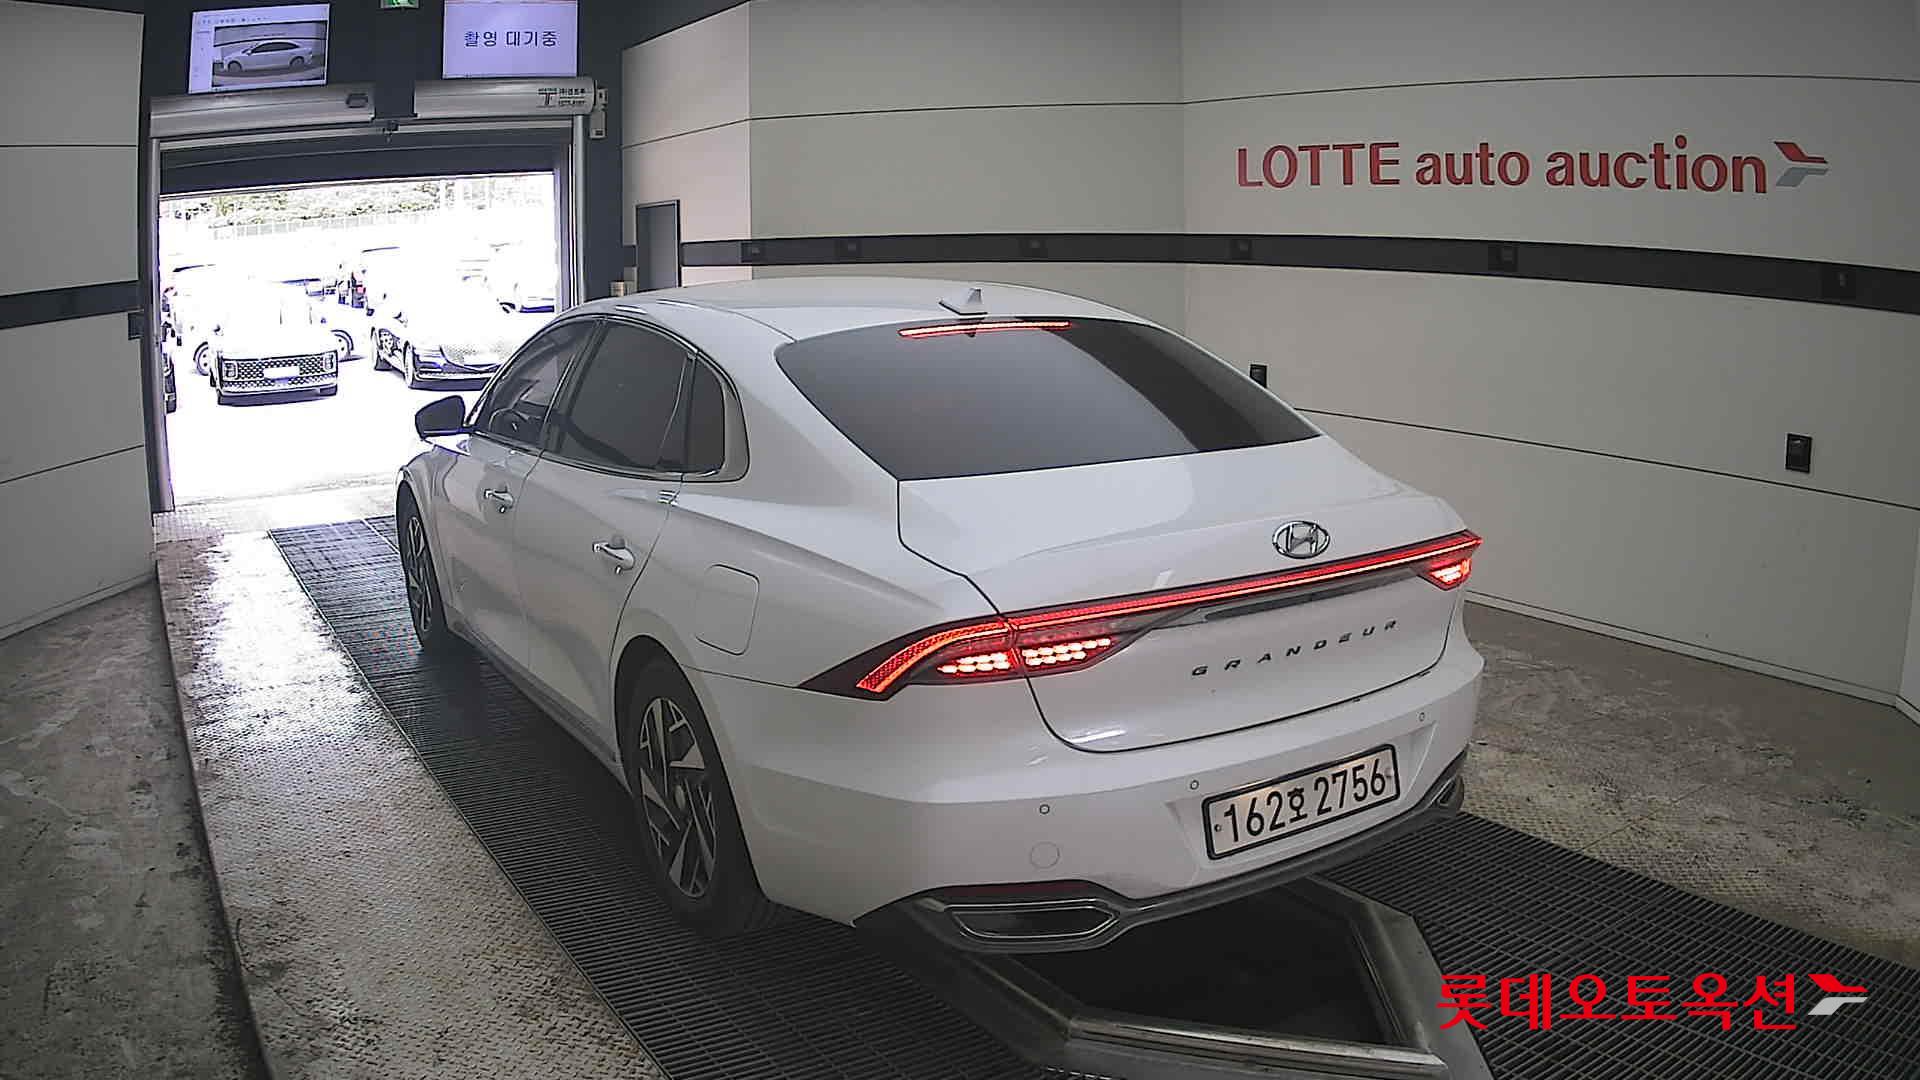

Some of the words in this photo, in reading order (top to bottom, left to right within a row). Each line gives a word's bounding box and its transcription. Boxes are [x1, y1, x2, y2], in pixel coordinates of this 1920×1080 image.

[464, 31, 497, 48] 촬영
[505, 31, 558, 48] 대기중
[1236, 141, 1400, 188] LOTTE
[1416, 142, 1530, 186] auto
[1546, 134, 1767, 194] auction
[1191, 619, 1397, 676] GRANDEUR
[1223, 787, 1308, 843] 162호
[1313, 758, 1386, 817] 2756
